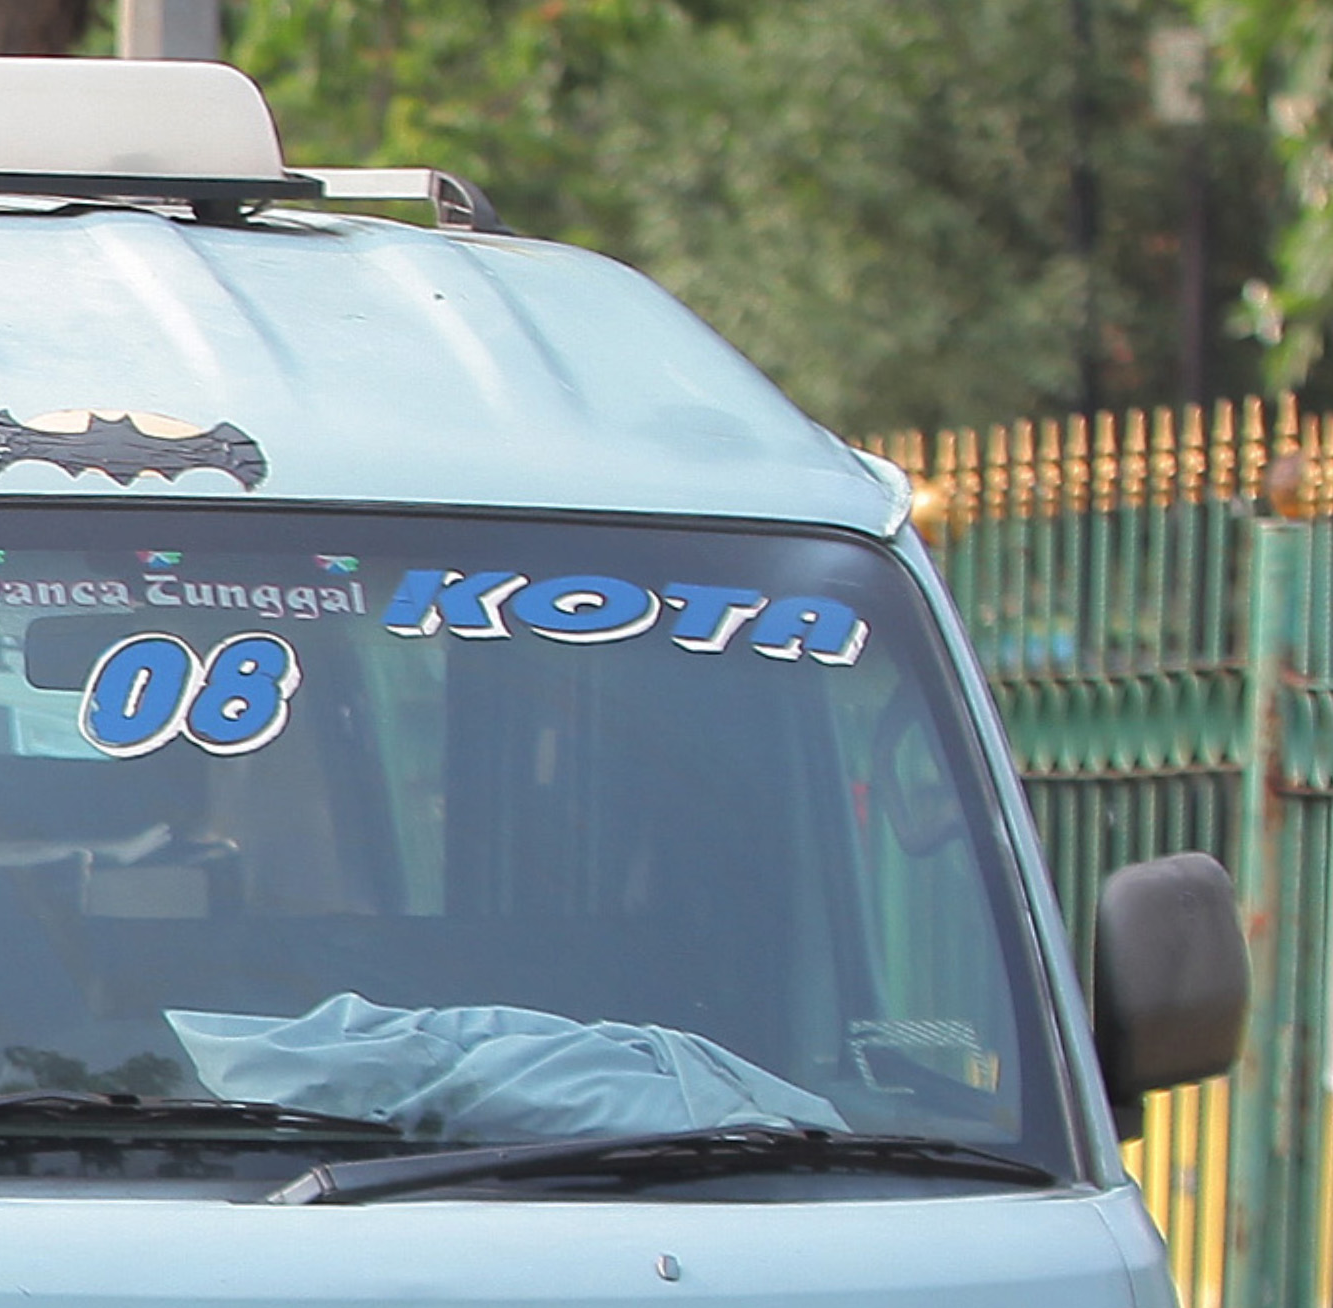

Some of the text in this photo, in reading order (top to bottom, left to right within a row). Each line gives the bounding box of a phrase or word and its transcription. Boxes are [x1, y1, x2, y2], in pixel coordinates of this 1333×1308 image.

[143, 574, 367, 619] Tunggal
[381, 569, 870, 667] KOTA
[78, 630, 303, 758] 08
